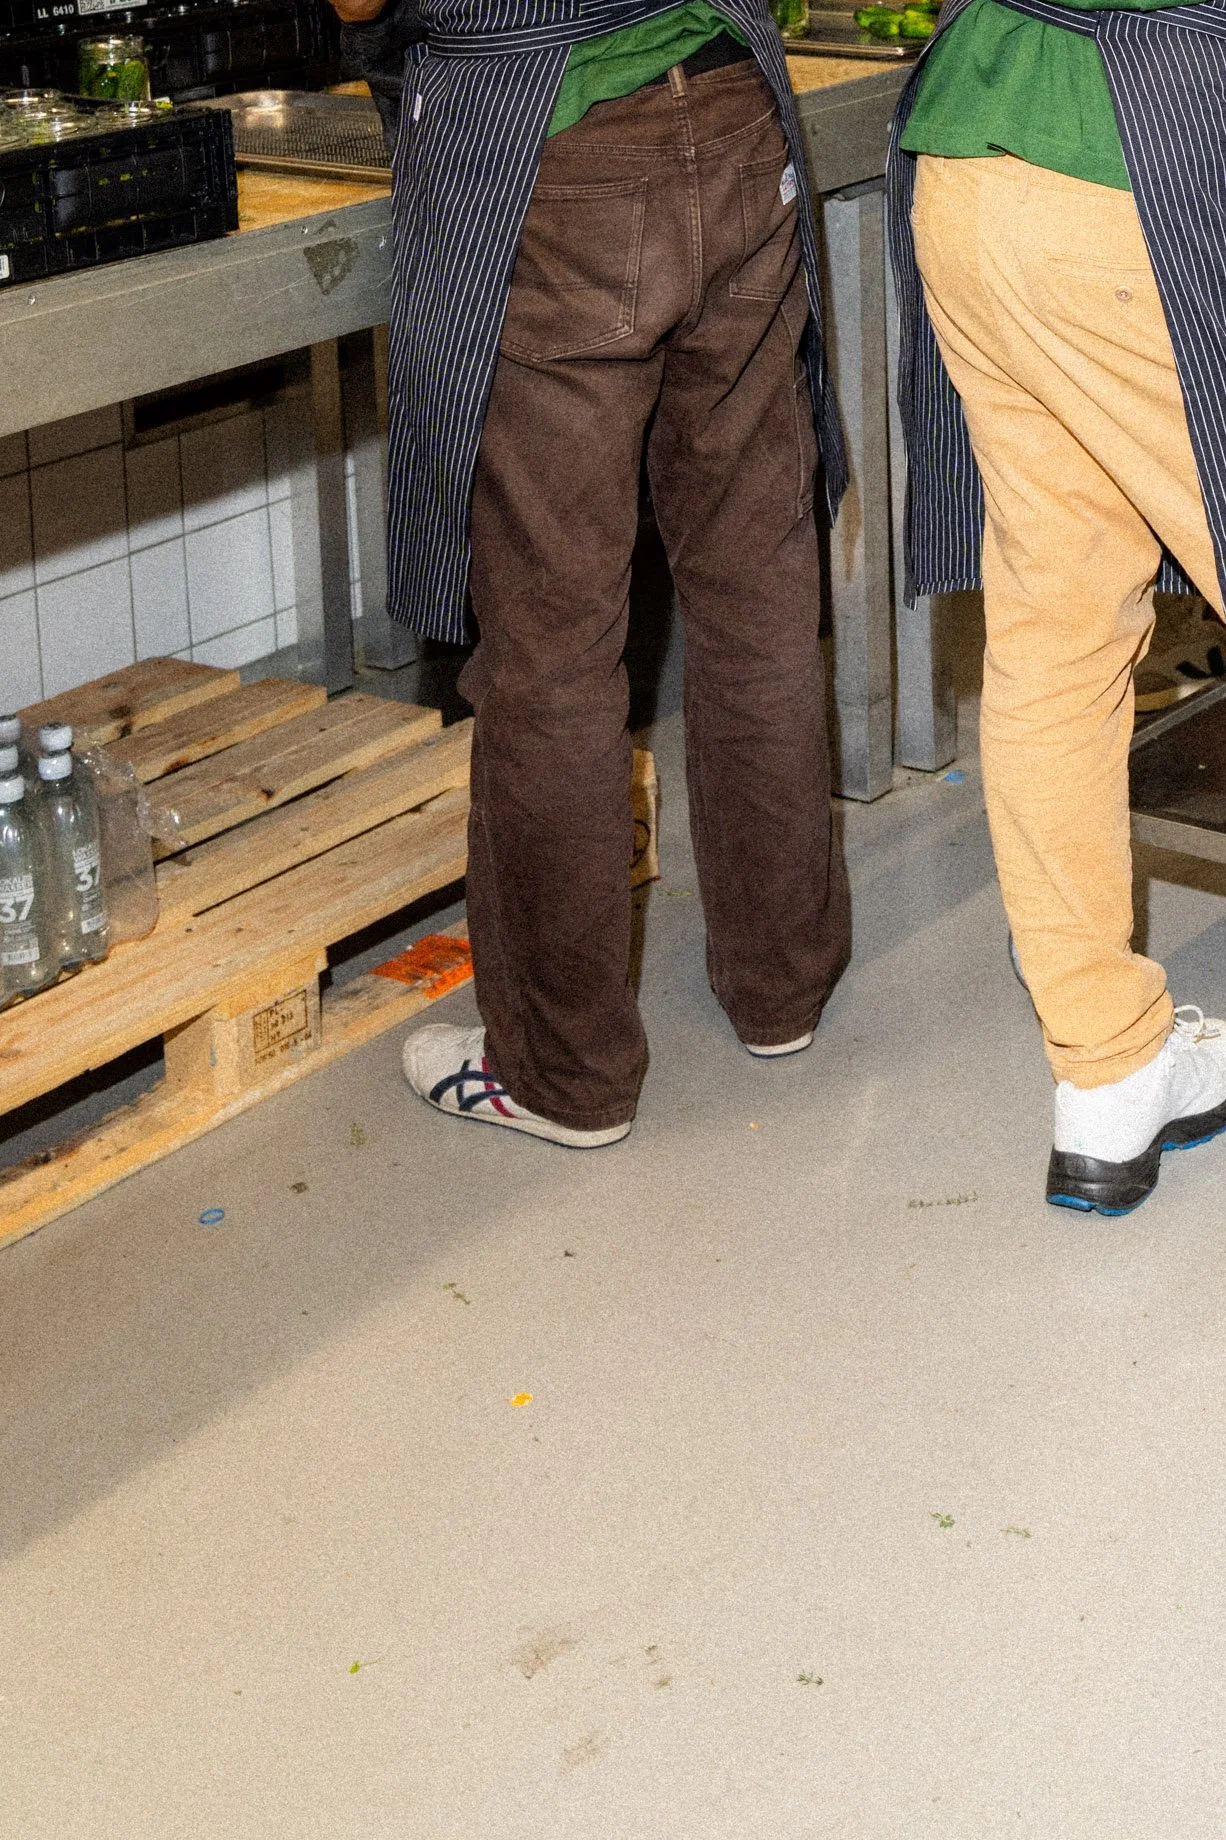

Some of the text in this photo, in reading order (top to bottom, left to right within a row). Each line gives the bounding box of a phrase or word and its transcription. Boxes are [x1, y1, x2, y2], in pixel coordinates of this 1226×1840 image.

[37, 4, 74, 19] LL 6410
[0, 894, 34, 922] 37
